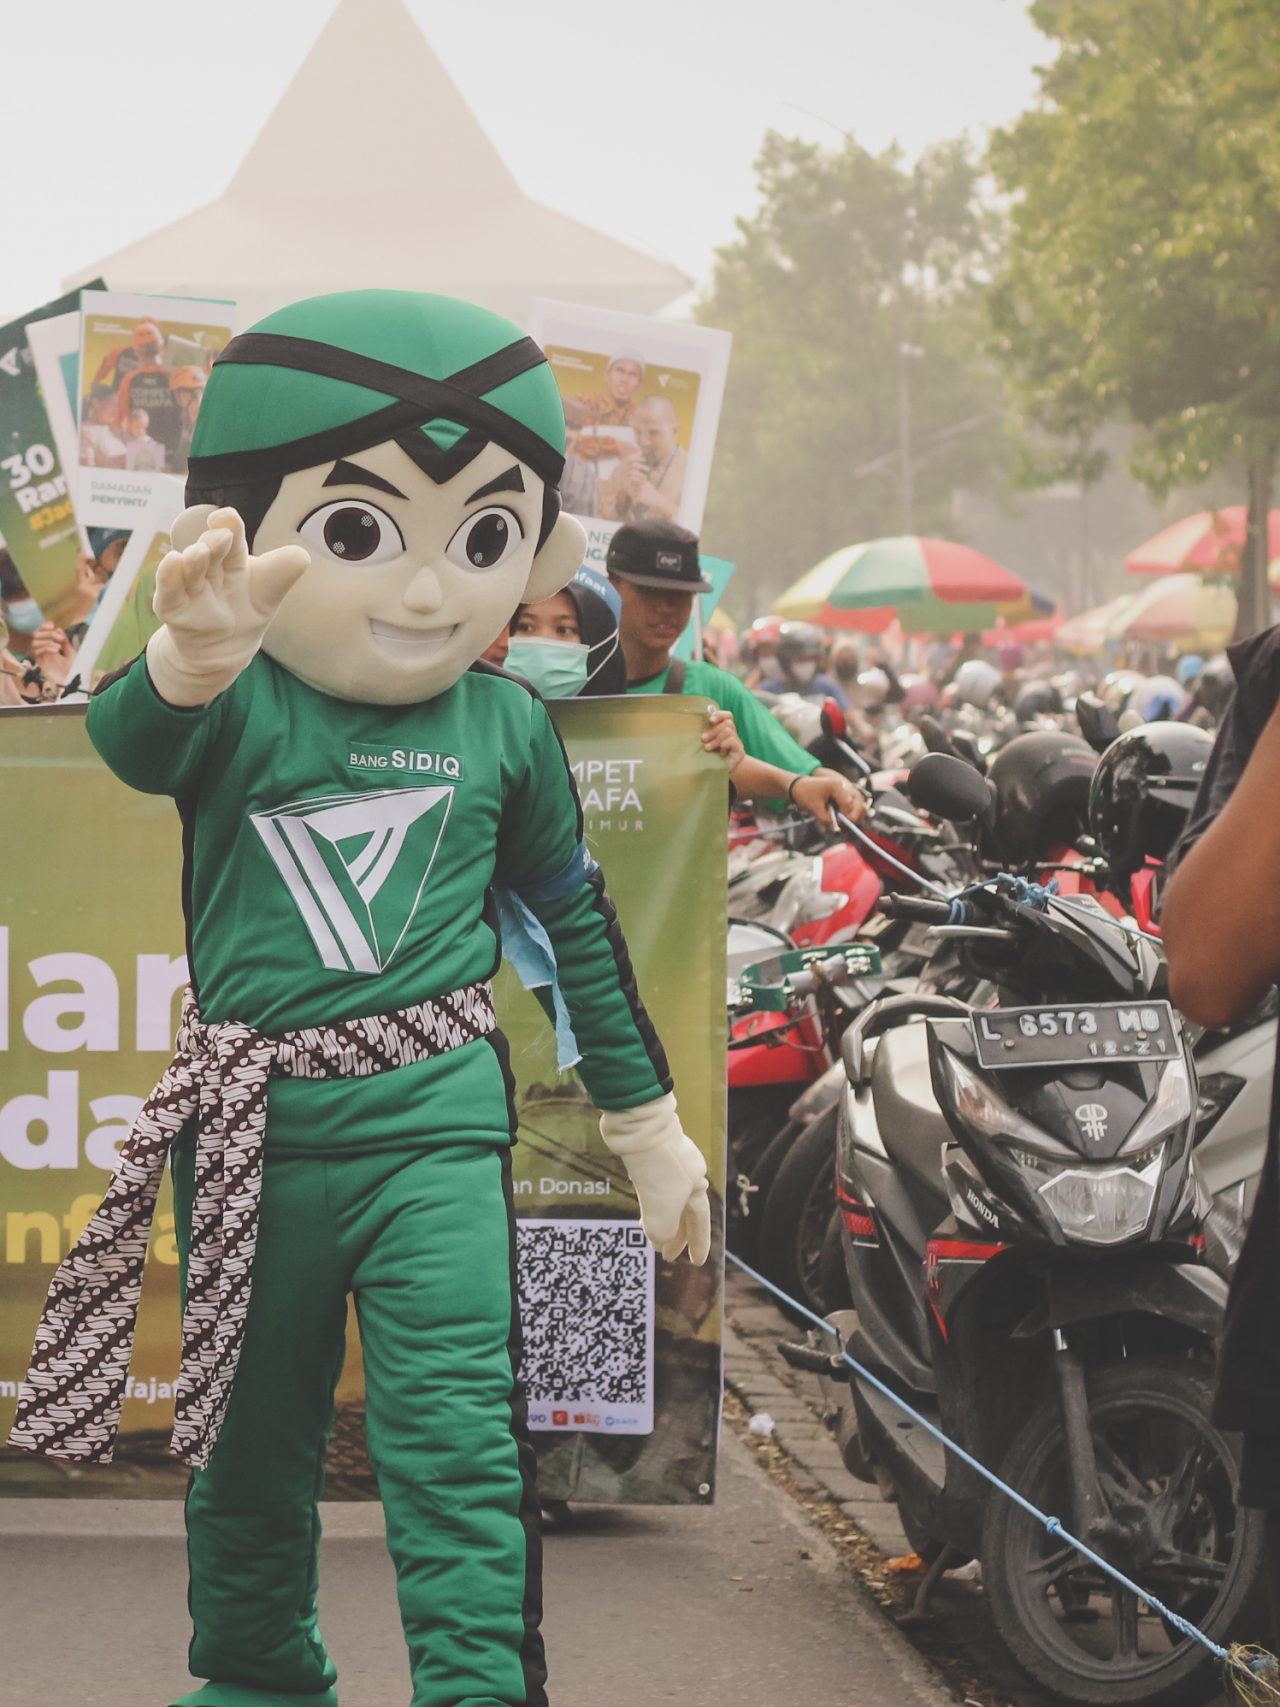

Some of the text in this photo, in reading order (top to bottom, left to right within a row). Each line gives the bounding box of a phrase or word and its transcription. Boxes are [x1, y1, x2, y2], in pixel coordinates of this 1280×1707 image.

[0, 443, 55, 490] 30
[91, 480, 152, 496] RAMADAN
[349, 750, 461, 778] BANG SIDIQ
[981, 1017, 1002, 1041] L
[1019, 1011, 1098, 1037] 6573
[540, 1177, 611, 1195] Donasi
[966, 1187, 1001, 1229] HONDA
